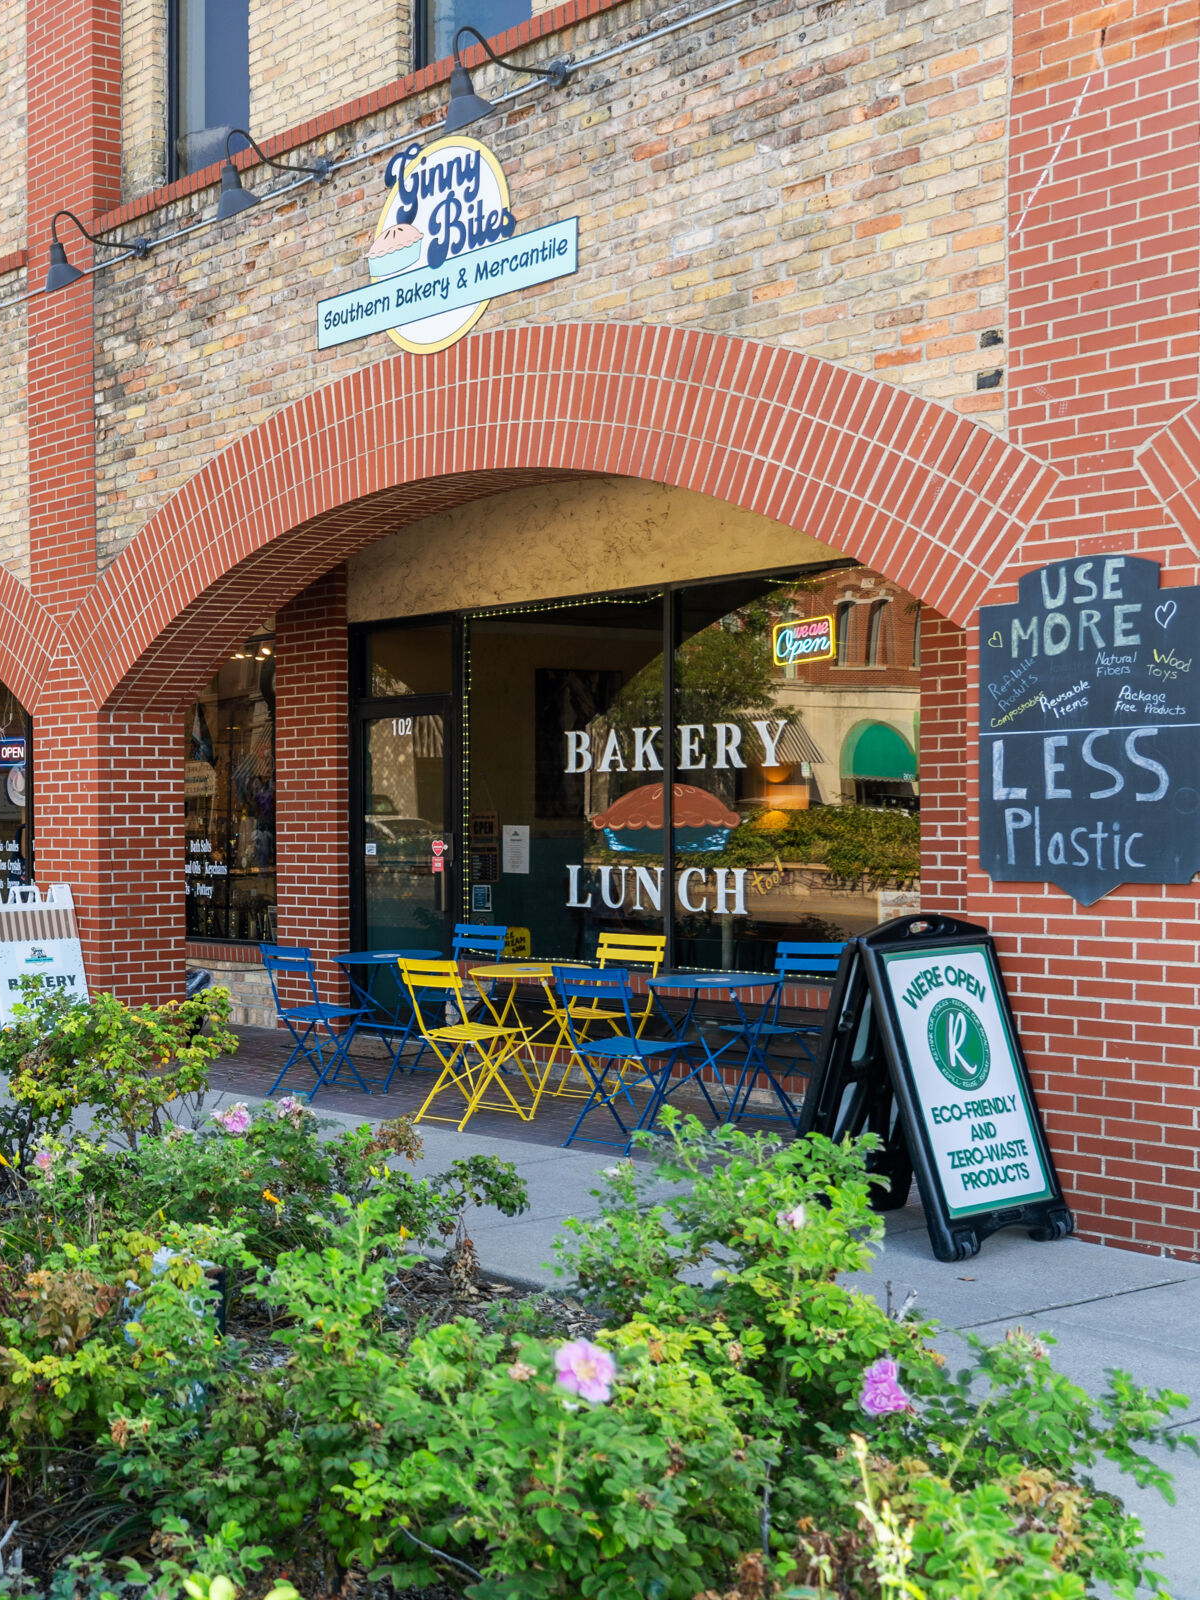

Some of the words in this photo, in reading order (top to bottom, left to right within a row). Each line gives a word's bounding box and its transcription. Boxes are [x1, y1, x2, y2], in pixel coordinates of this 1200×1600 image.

[385, 142, 481, 225] Ginny
[427, 190, 516, 269] Bites
[324, 295, 391, 331] Southern
[396, 276, 451, 309] Bakery
[456, 267, 468, 290] &
[474, 237, 569, 285] Mercantile
[1040, 557, 1126, 610] USE
[775, 628, 831, 664] Open
[1011, 603, 1142, 659] MORE
[1095, 651, 1138, 667] Natural
[1096, 666, 1131, 678] Fibers
[1146, 664, 1179, 683] Toys
[1153, 648, 1193, 673] Wood
[990, 690, 1045, 728] Compostables
[1039, 680, 1091, 713] Reusable
[1052, 696, 1089, 719] Items
[1114, 700, 1138, 714] Free
[1144, 702, 1187, 716] Products
[1118, 685, 1167, 706] Package
[391, 718, 413, 737] 102
[1, 746, 25, 759] OPEN
[564, 720, 788, 774] BAKERY
[992, 727, 1170, 802] LESS
[190, 839, 200, 852] Bath
[201, 839, 212, 852] Salts
[1004, 806, 1147, 871] Plastic
[192, 860, 201, 874] Oils
[205, 860, 227, 878] Keychains
[196, 882, 213, 899] Pottery
[566, 864, 749, 915] LUNCH
[751, 855, 786, 896] too!
[901, 965, 944, 1010] WE'RE
[944, 965, 986, 1003] OPEN
[947, 1012, 977, 1075] R
[931, 1094, 1016, 1125] ECO-FRIENDLY
[971, 1121, 997, 1142] AND
[947, 1139, 1028, 1169] ZERO-WASTE
[960, 1162, 1030, 1191] PRODUCTS
